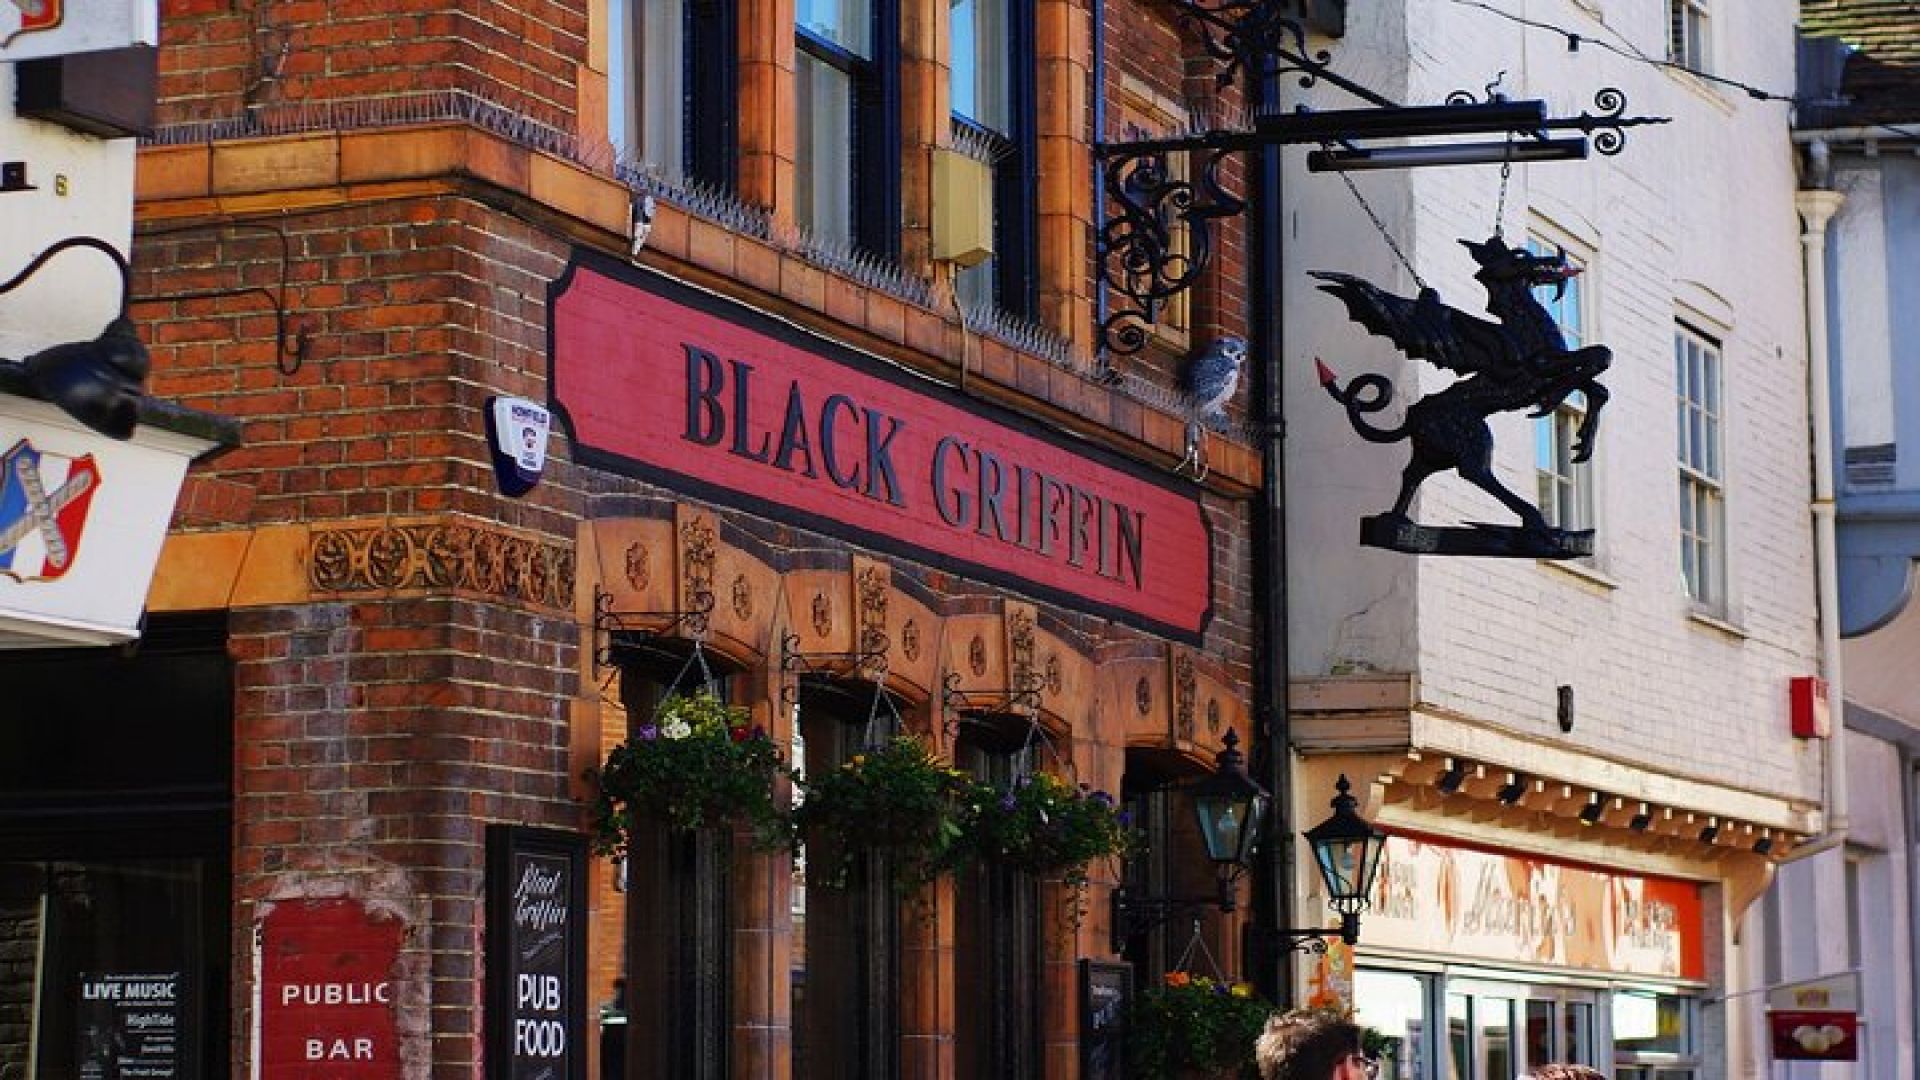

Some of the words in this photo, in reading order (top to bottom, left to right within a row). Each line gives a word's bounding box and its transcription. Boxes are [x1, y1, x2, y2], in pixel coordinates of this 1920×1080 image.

[680, 341, 908, 509] BLACK
[931, 435, 1147, 592] GRIFFIN
[82, 982, 121, 999] LIVE
[125, 982, 177, 999] MUSIC
[281, 982, 391, 1007] PUBLIC
[516, 973, 561, 1011] PUB
[305, 1038, 374, 1061] BAR
[514, 1018, 565, 1058] FOOD
